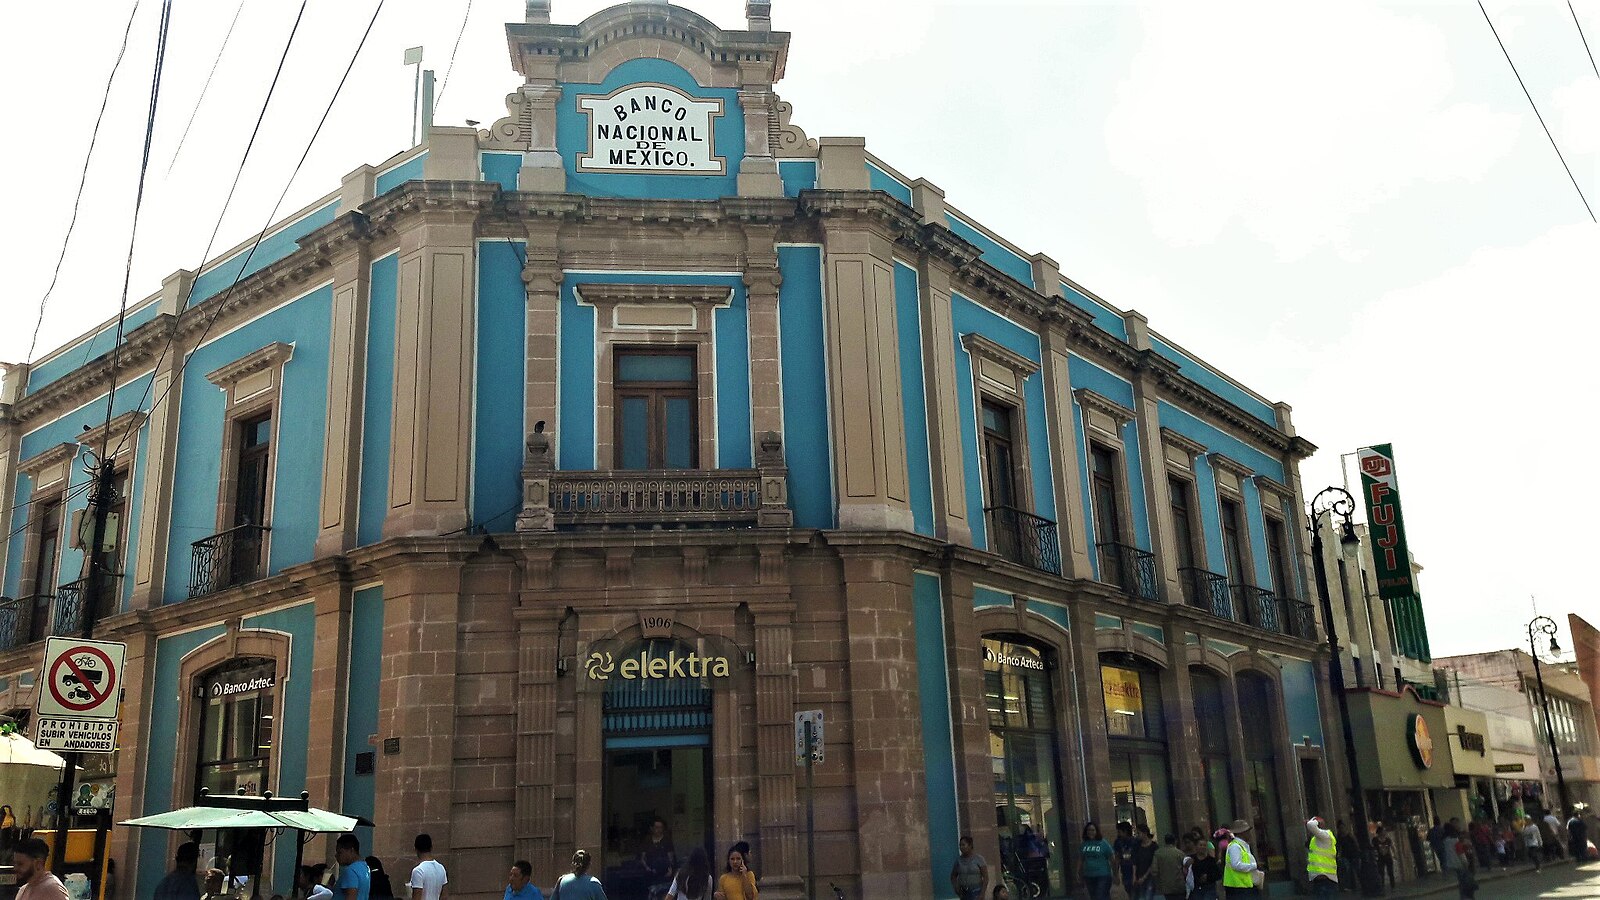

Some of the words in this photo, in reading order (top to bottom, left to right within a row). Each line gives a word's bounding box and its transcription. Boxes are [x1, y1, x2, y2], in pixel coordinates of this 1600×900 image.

[614, 96, 687, 122] BANCO
[598, 124, 703, 142] NACIONAL
[636, 141, 666, 149] DE
[609, 149, 695, 167] MEXICO.
[1370, 482, 1398, 571] FUJI
[643, 617, 672, 629] 1906
[620, 650, 730, 680] elektra
[997, 652, 1020, 667] Banco
[1020, 656, 1044, 670] Azteca
[223, 682, 248, 695] Banco
[41, 720, 113, 731] PROHIBIDO
[41, 730, 65, 738] SUBIR
[69, 731, 112, 740] VEHICULOS
[40, 739, 51, 747] EN
[64, 740, 111, 749] ANDADORES
